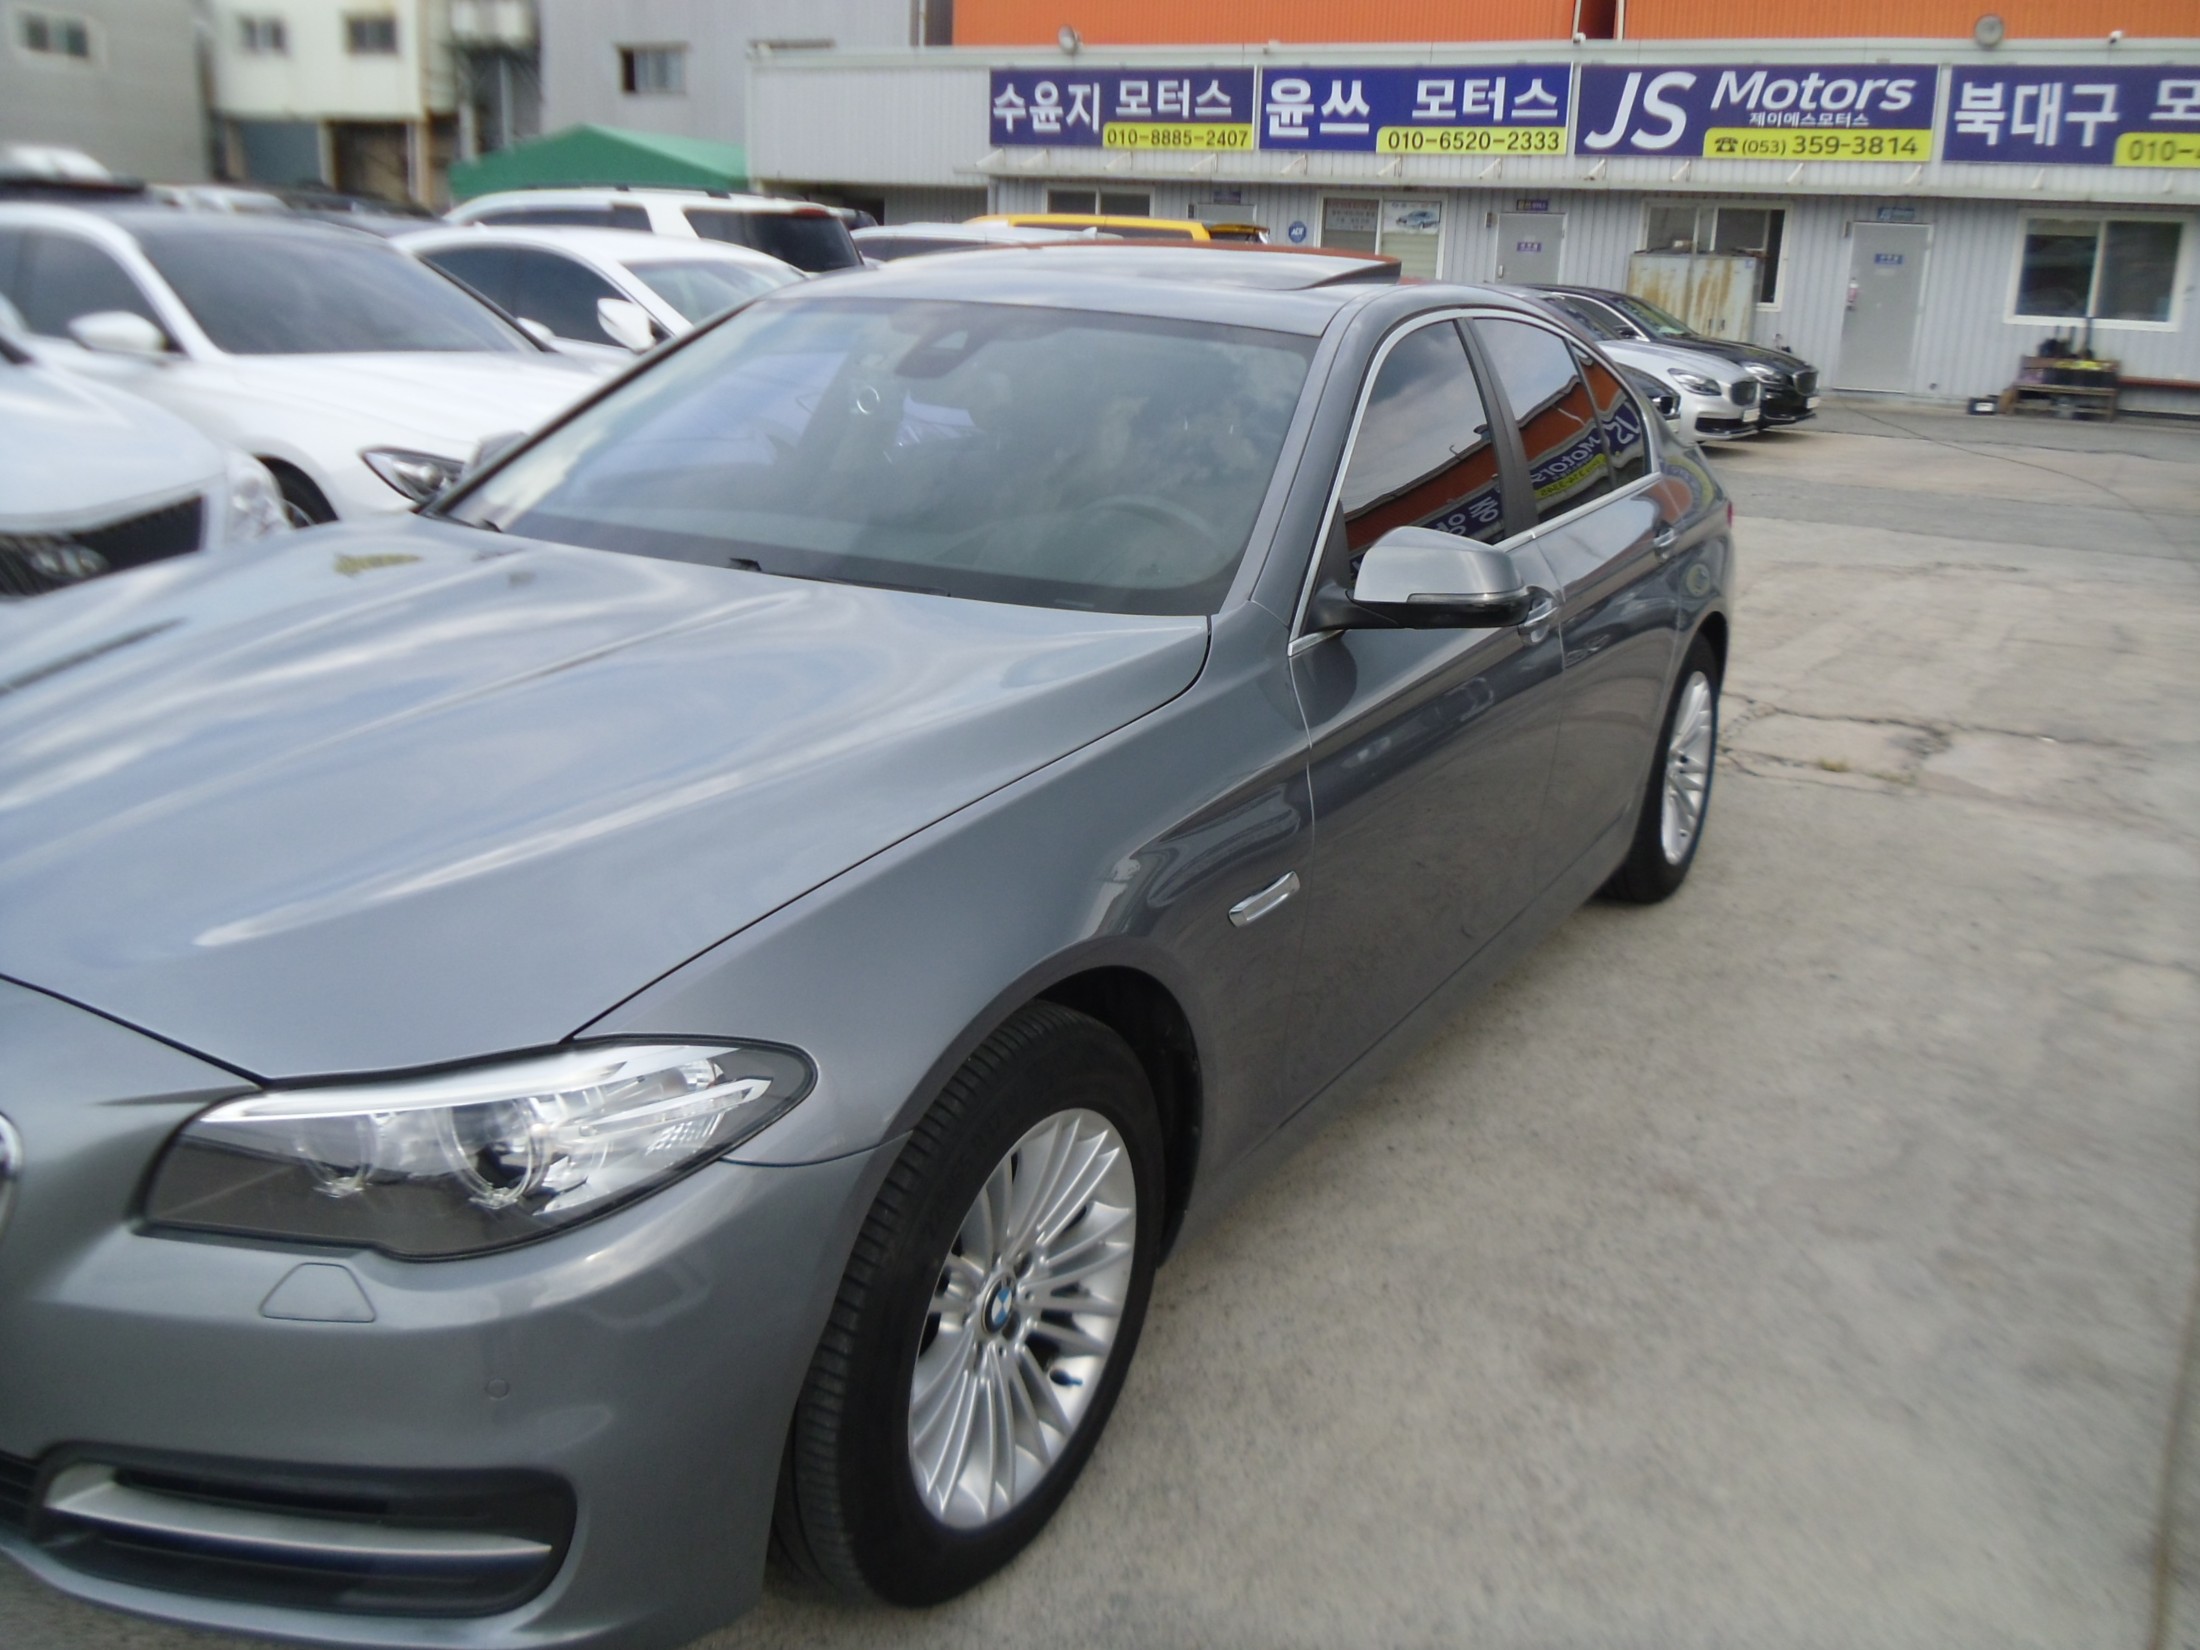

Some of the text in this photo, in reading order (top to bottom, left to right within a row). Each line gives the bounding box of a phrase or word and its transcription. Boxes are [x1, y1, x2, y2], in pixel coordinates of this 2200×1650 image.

[993, 79, 1232, 133] 수윤지 모터스
[1266, 76, 1558, 138] 윤쓰 모터스
[1584, 71, 1917, 149] JS Motors
[1749, 111, 1870, 127] 제이에스모터스
[1954, 82, 2119, 147] 북대구
[1107, 129, 1248, 147] 010-8885-2407
[1388, 131, 1559, 151] 010-6520-2333
[1741, 136, 1918, 155] (053) 359-3814
